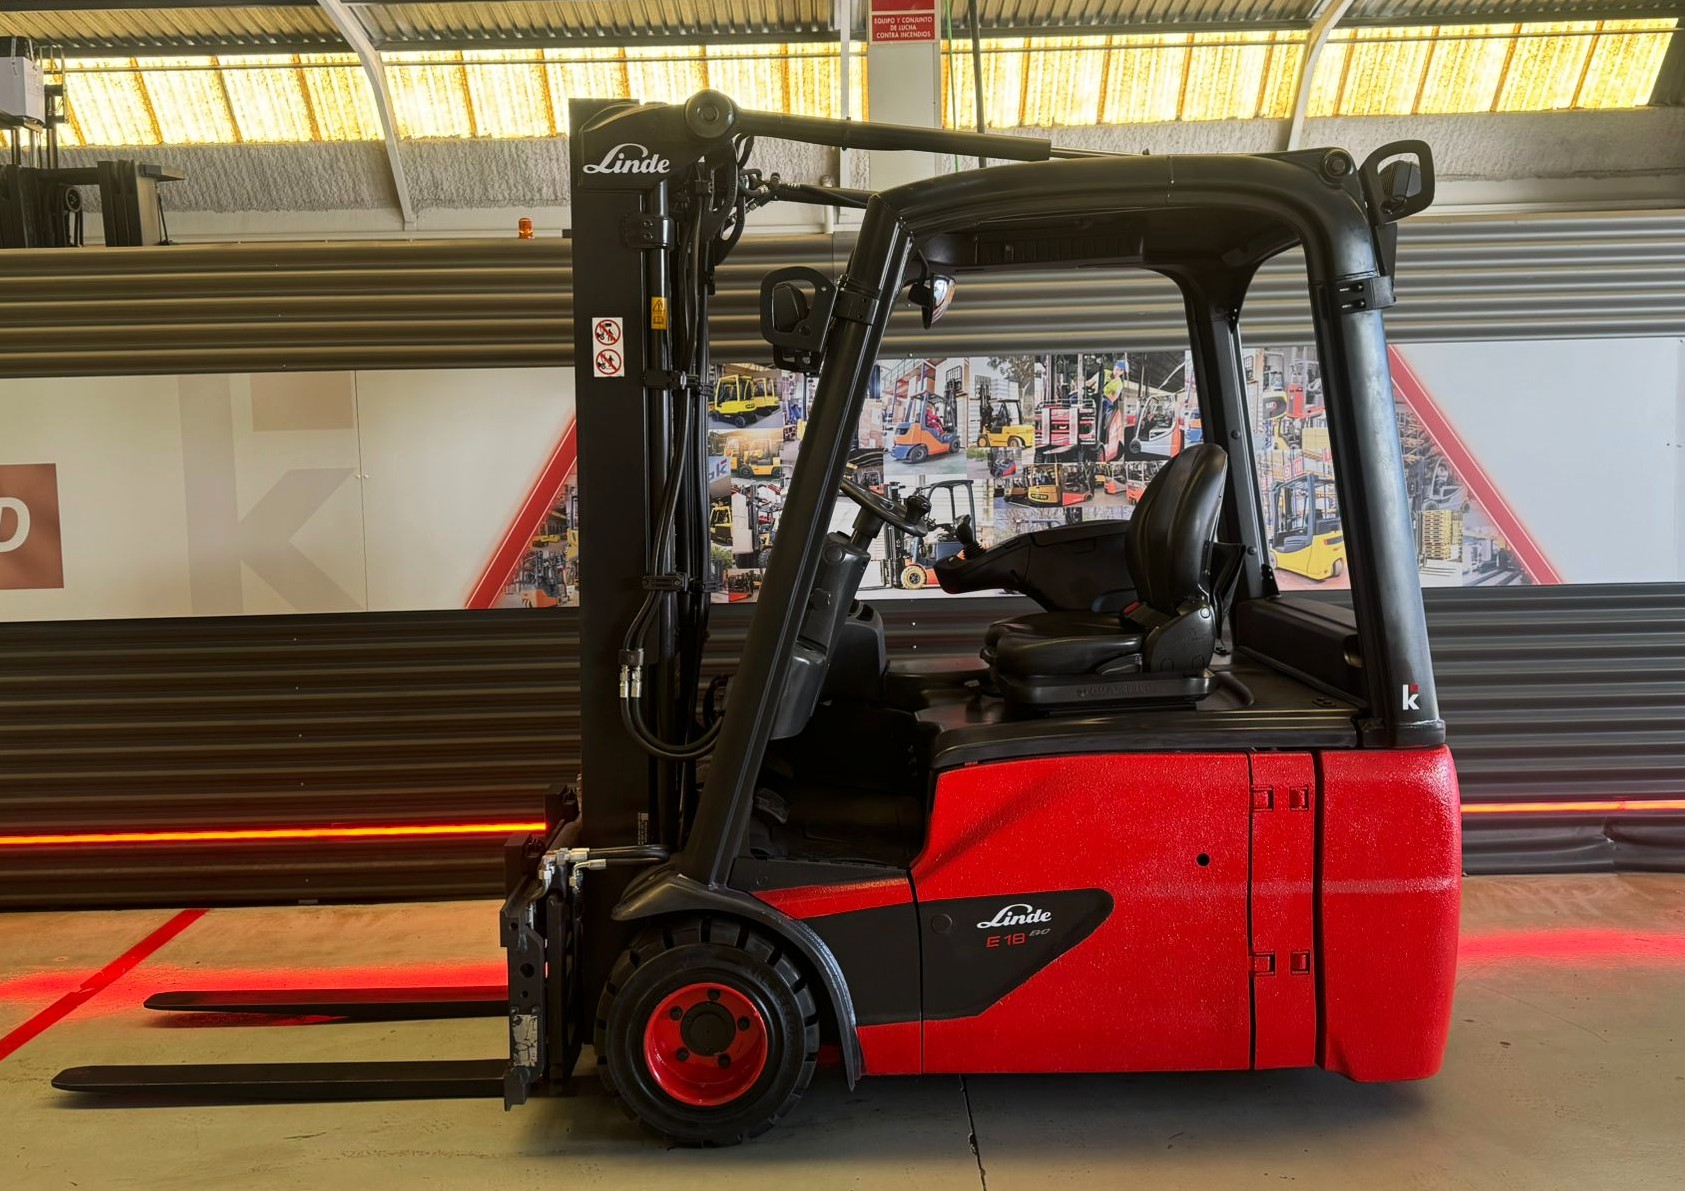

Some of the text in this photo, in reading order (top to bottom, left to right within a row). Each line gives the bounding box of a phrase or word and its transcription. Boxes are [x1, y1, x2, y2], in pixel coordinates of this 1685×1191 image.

[582, 143, 671, 174] Linde
[976, 903, 1052, 929] Linde
[986, 936, 1001, 948] E
[1004, 933, 1026, 946] 18
